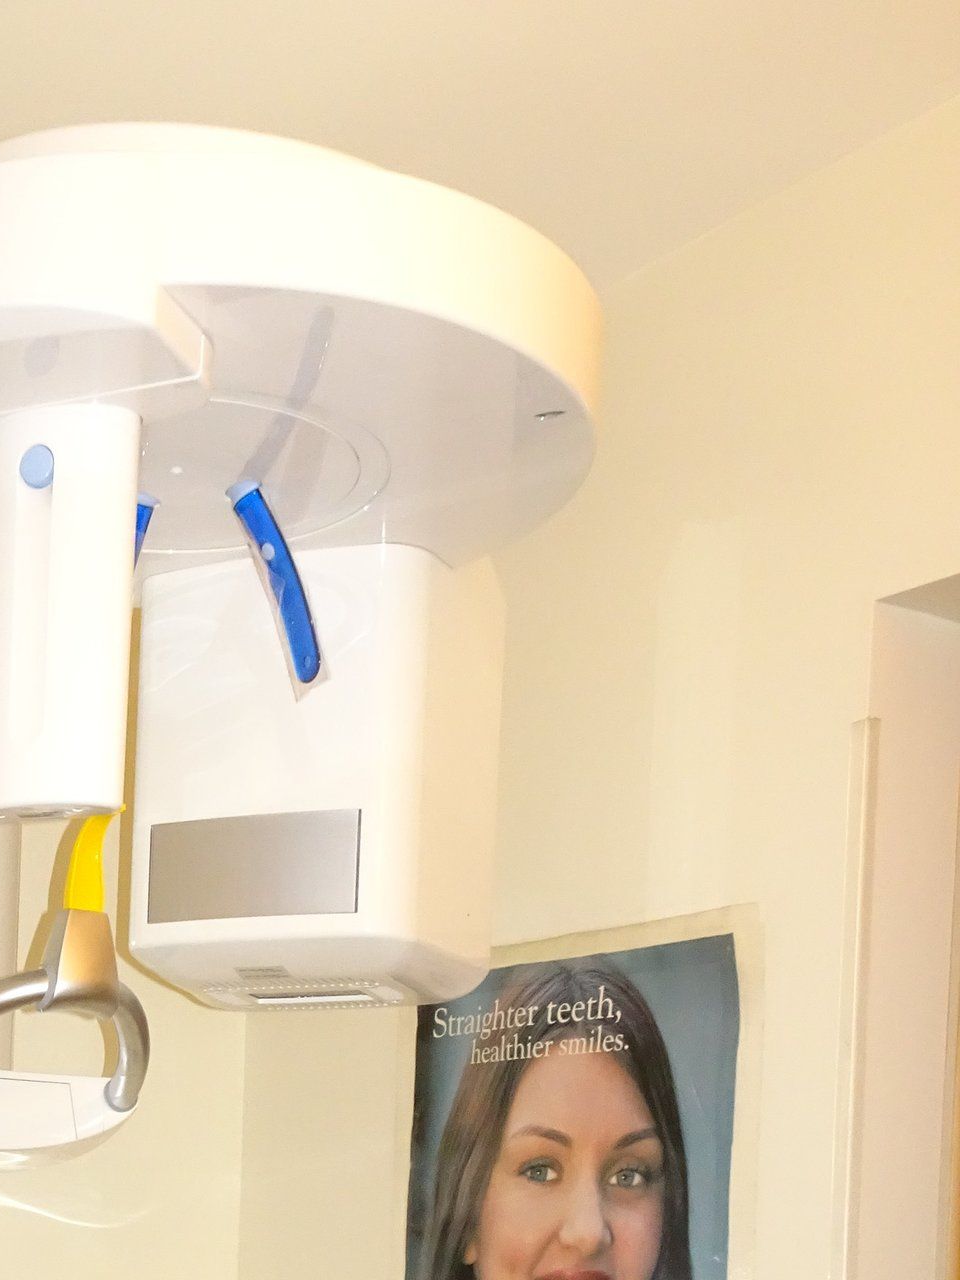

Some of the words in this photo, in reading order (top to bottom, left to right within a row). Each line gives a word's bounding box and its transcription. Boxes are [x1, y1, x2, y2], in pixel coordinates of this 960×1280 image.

[432, 999, 539, 1040] Straighter
[546, 985, 622, 1026] teeth,
[470, 1034, 553, 1065] healthier
[558, 1026, 630, 1056] smiles.
